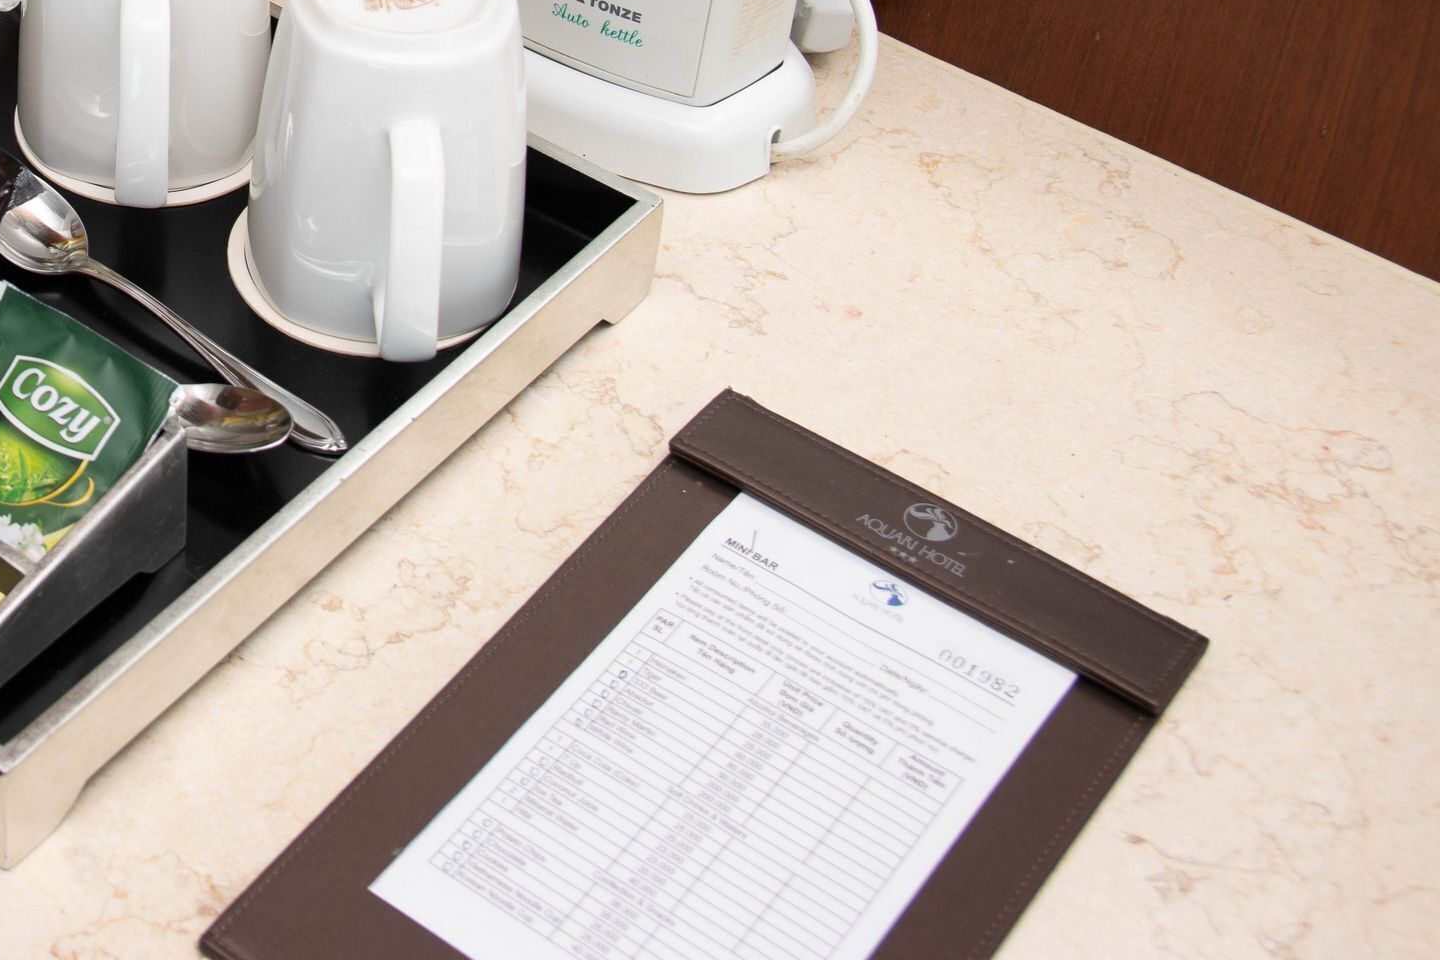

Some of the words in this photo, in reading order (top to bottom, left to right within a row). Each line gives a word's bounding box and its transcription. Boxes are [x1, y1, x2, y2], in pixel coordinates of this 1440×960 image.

[552, 2, 589, 28] Auto
[600, 19, 644, 48] kettle
[12, 367, 101, 444] Cozy
[725, 537, 752, 554] MINI
[751, 552, 778, 570] BAR
[856, 513, 918, 550] AQUARI
[918, 545, 966, 578] HOTEL
[701, 564, 725, 580] Room
[655, 615, 674, 627] PAR
[708, 644, 755, 673] Description
[939, 649, 1019, 697] 001982
